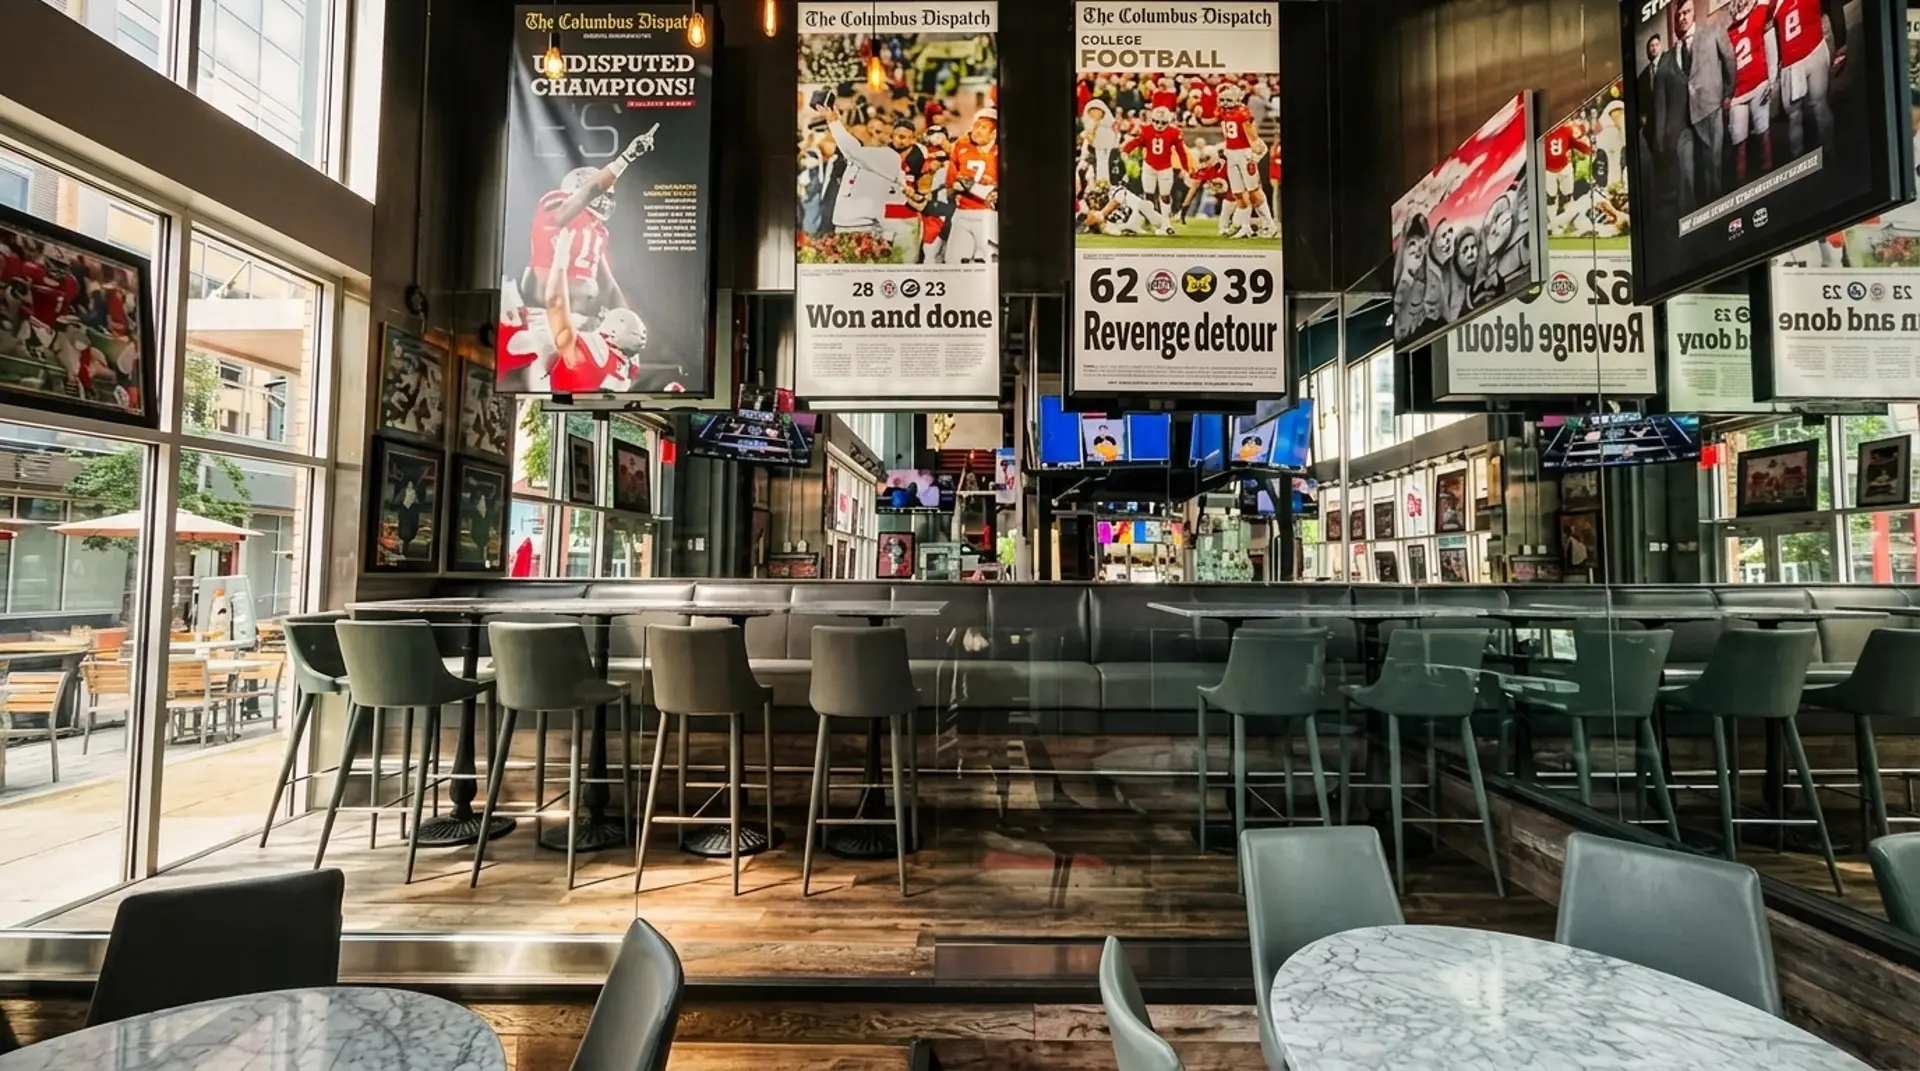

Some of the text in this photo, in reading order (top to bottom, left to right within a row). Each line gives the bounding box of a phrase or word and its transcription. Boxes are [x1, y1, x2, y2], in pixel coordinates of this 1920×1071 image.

[525, 12, 554, 32] The
[559, 13, 633, 31] Columbus
[806, 9, 990, 29] The Columbus Dispatch
[1083, 7, 1272, 27] The Columbus Dispatch
[1081, 35, 1142, 45] COLLEGE
[1081, 50, 1225, 68] FOOTBALL
[530, 77, 695, 97] CHAMPIONS!
[967, 160, 986, 182] 7
[852, 281, 946, 297] 28 23
[1090, 267, 1274, 304] 62 39
[806, 303, 993, 329] Won and done
[1083, 310, 1278, 360] Revenge detour
